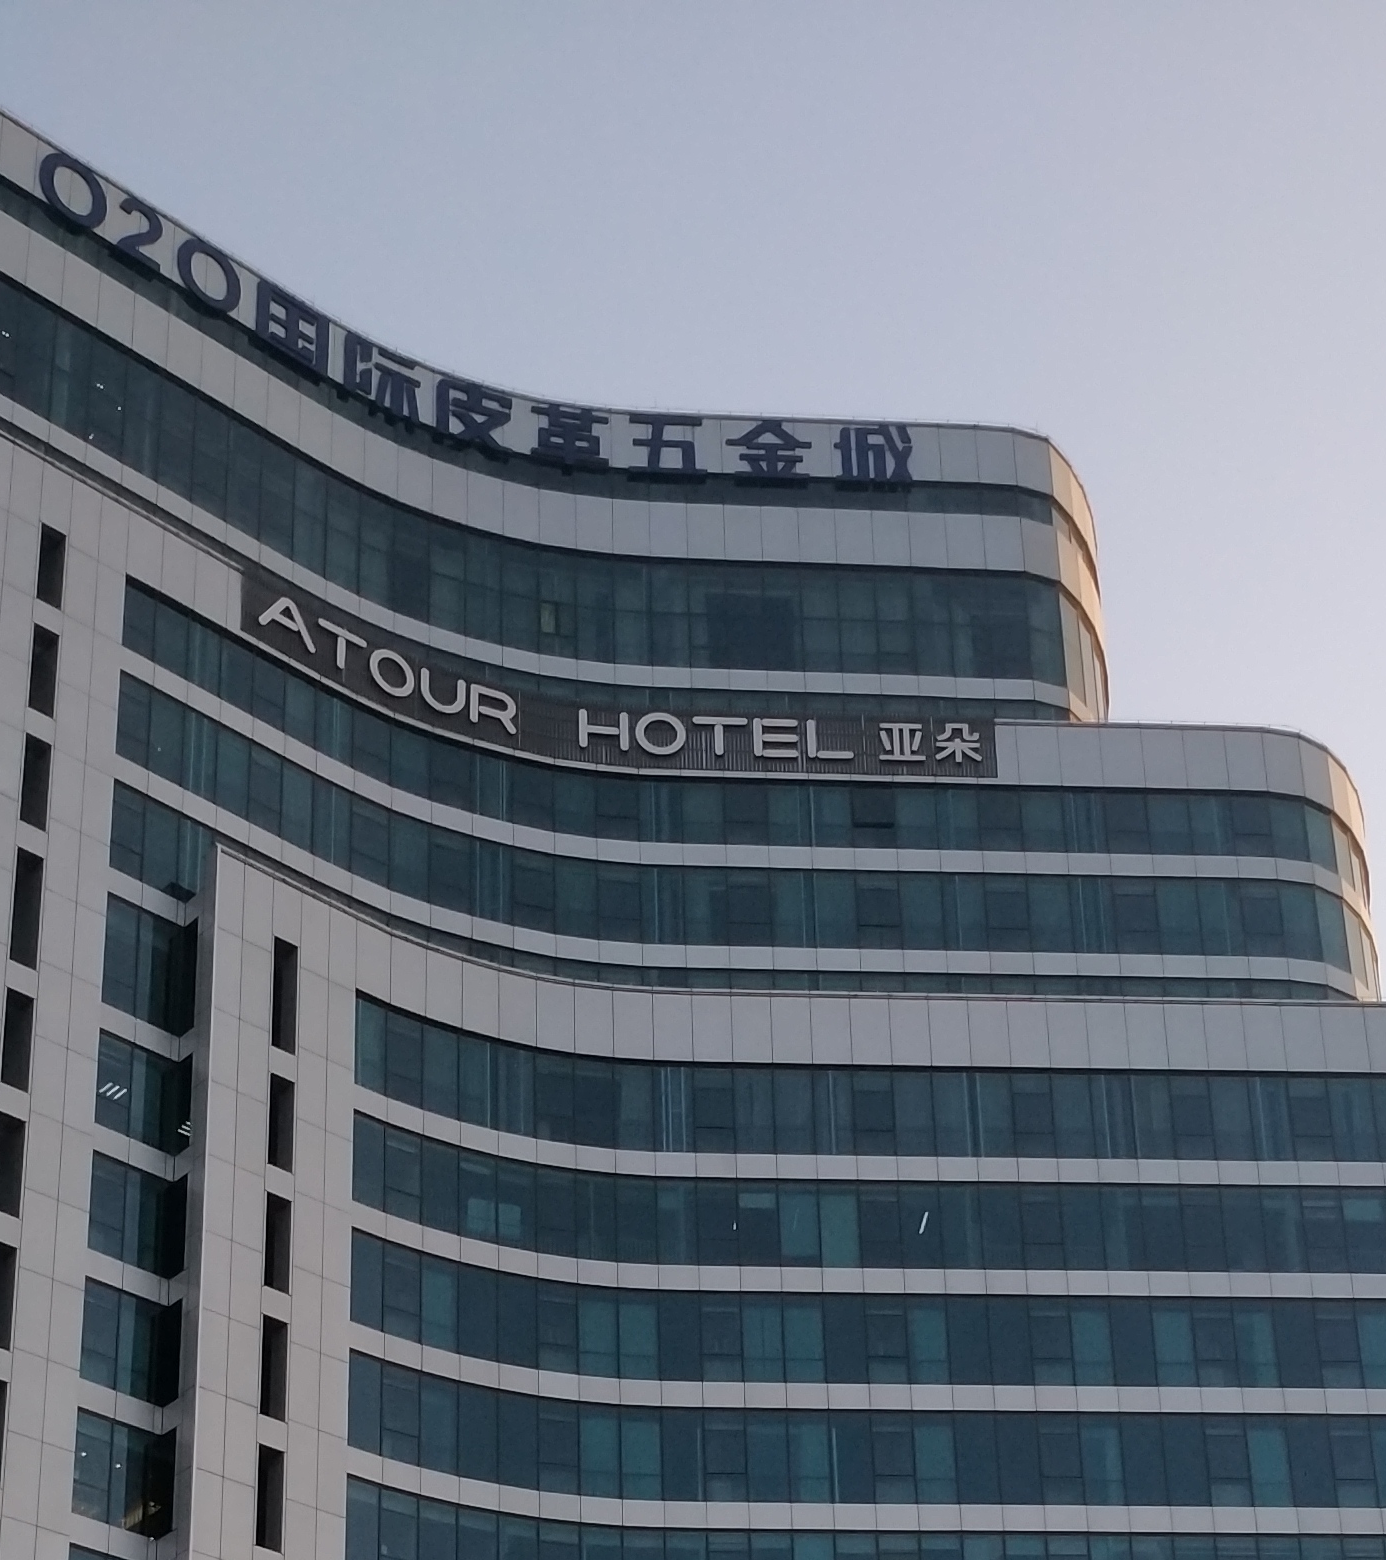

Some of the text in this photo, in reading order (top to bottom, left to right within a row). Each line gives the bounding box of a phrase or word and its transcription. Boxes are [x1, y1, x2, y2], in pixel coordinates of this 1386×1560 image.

[257, 594, 983, 764] ATOUR HOTEL 亚朵
